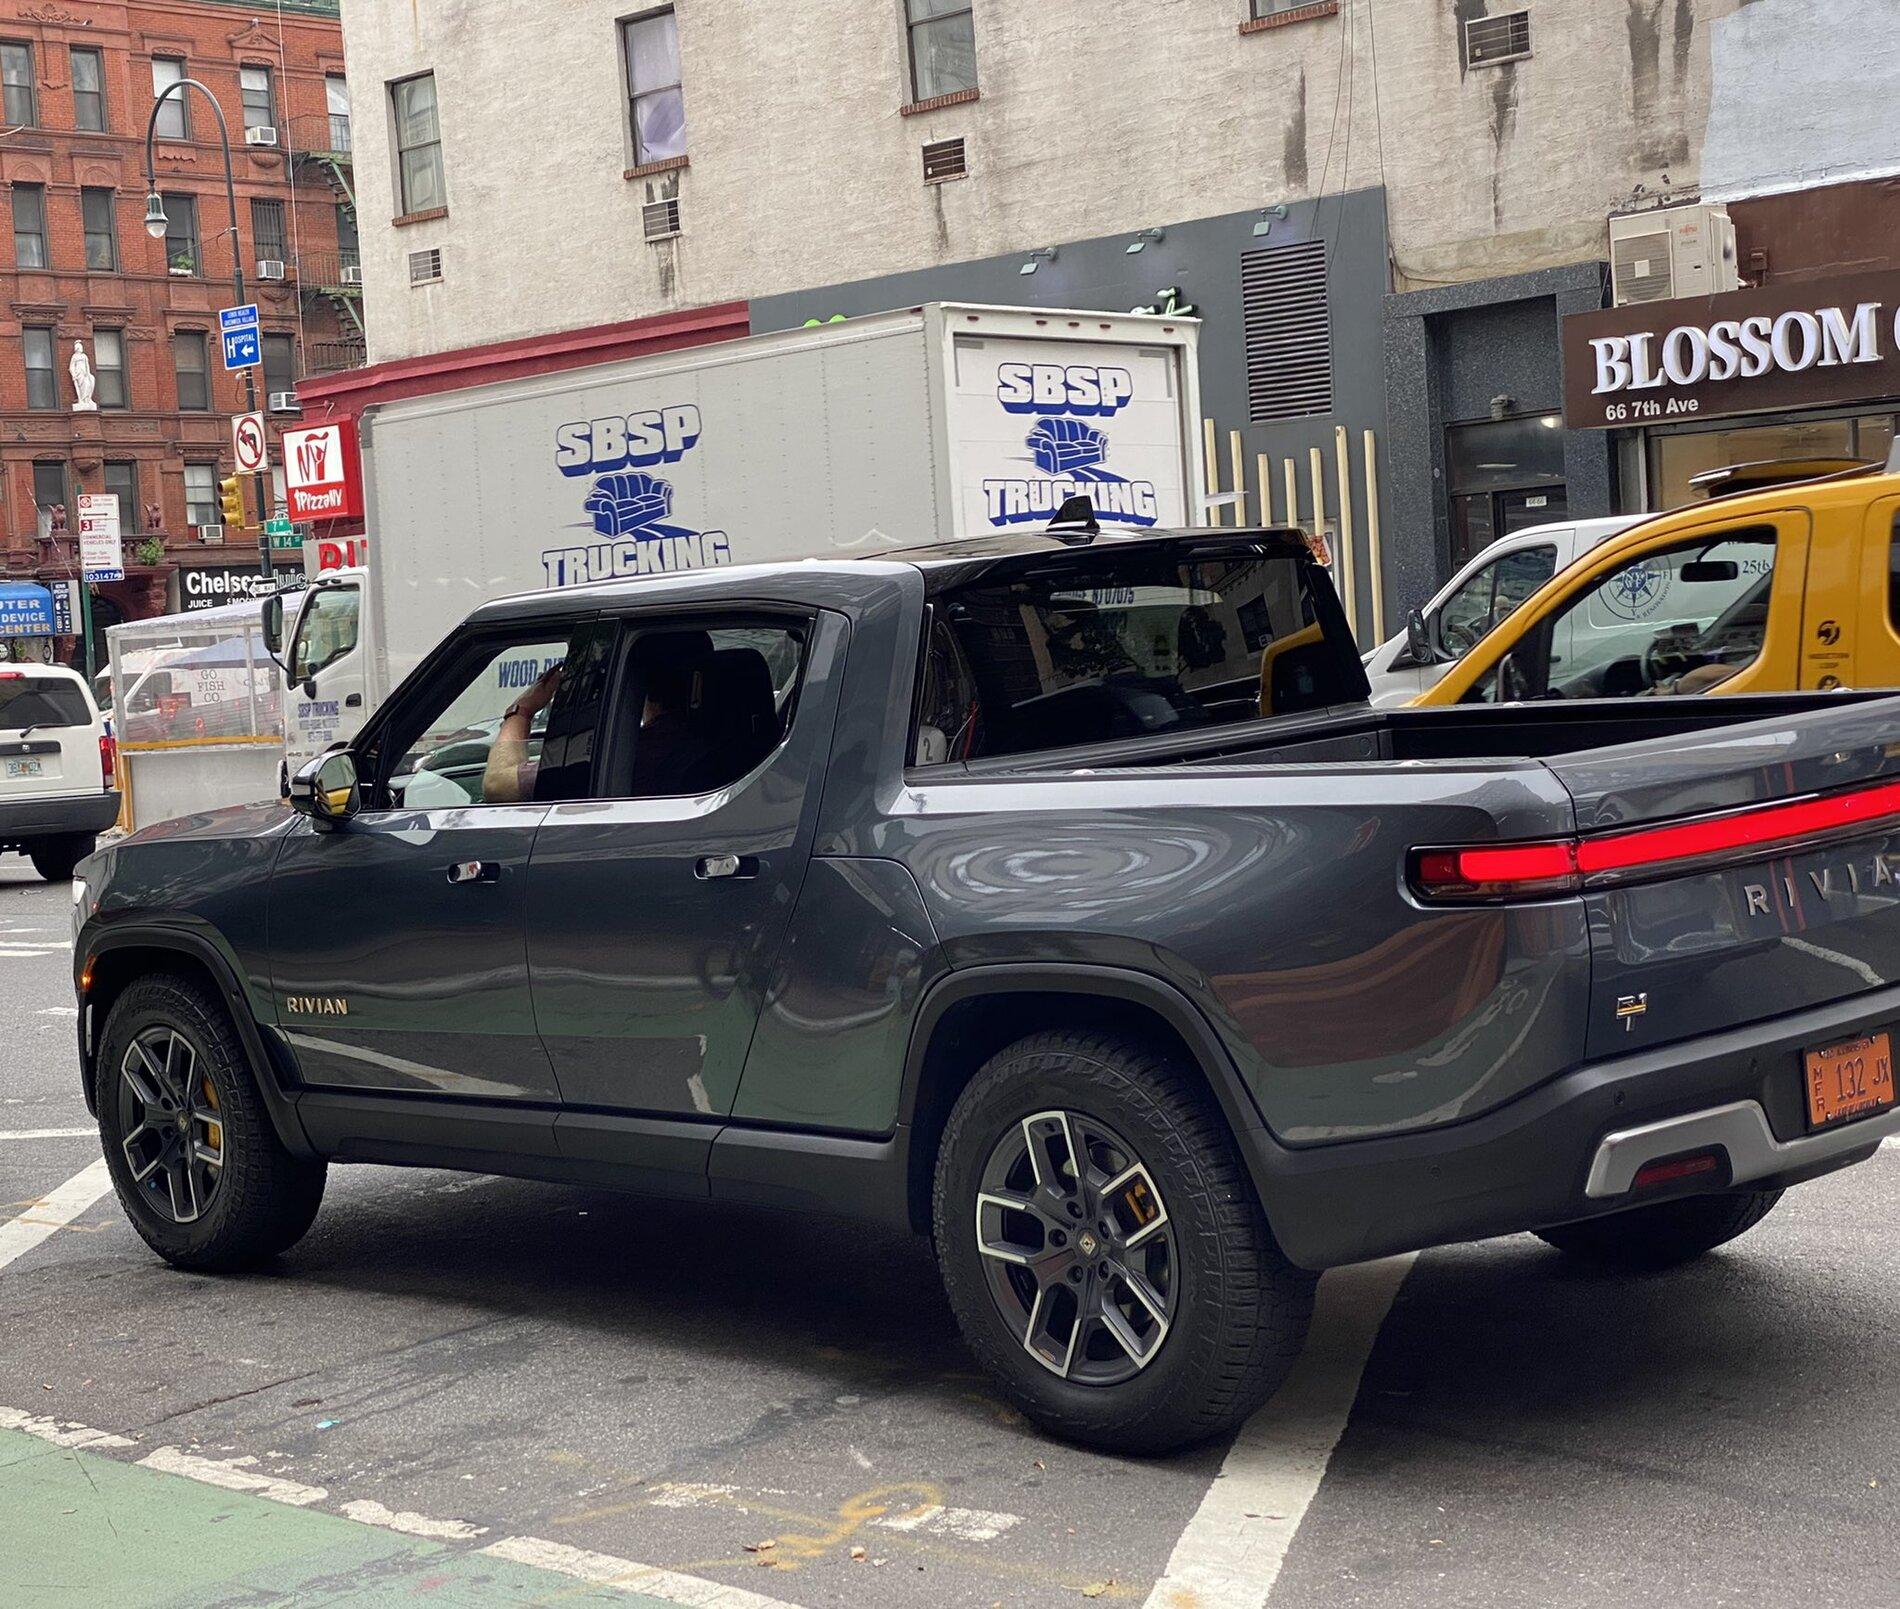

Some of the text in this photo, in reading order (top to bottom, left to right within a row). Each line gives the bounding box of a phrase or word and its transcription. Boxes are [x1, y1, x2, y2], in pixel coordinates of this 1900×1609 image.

[1589, 302, 1884, 394] BLOSSOM
[997, 363, 1133, 417] SBSP
[1606, 397, 1699, 421] 66 7th Ave
[556, 404, 702, 477] SBSP
[983, 479, 1158, 526] TRUCKING
[284, 537, 292, 547] 14
[542, 531, 732, 588] TRUCKING
[188, 600, 213, 608] JUICE
[1, 612, 46, 623] DEVICE
[197, 681, 225, 692] FISH
[201, 669, 217, 680] GO
[286, 997, 348, 1015] RIVIAN
[1836, 1057, 1866, 1101] 132
[1872, 1056, 1890, 1085] JX
